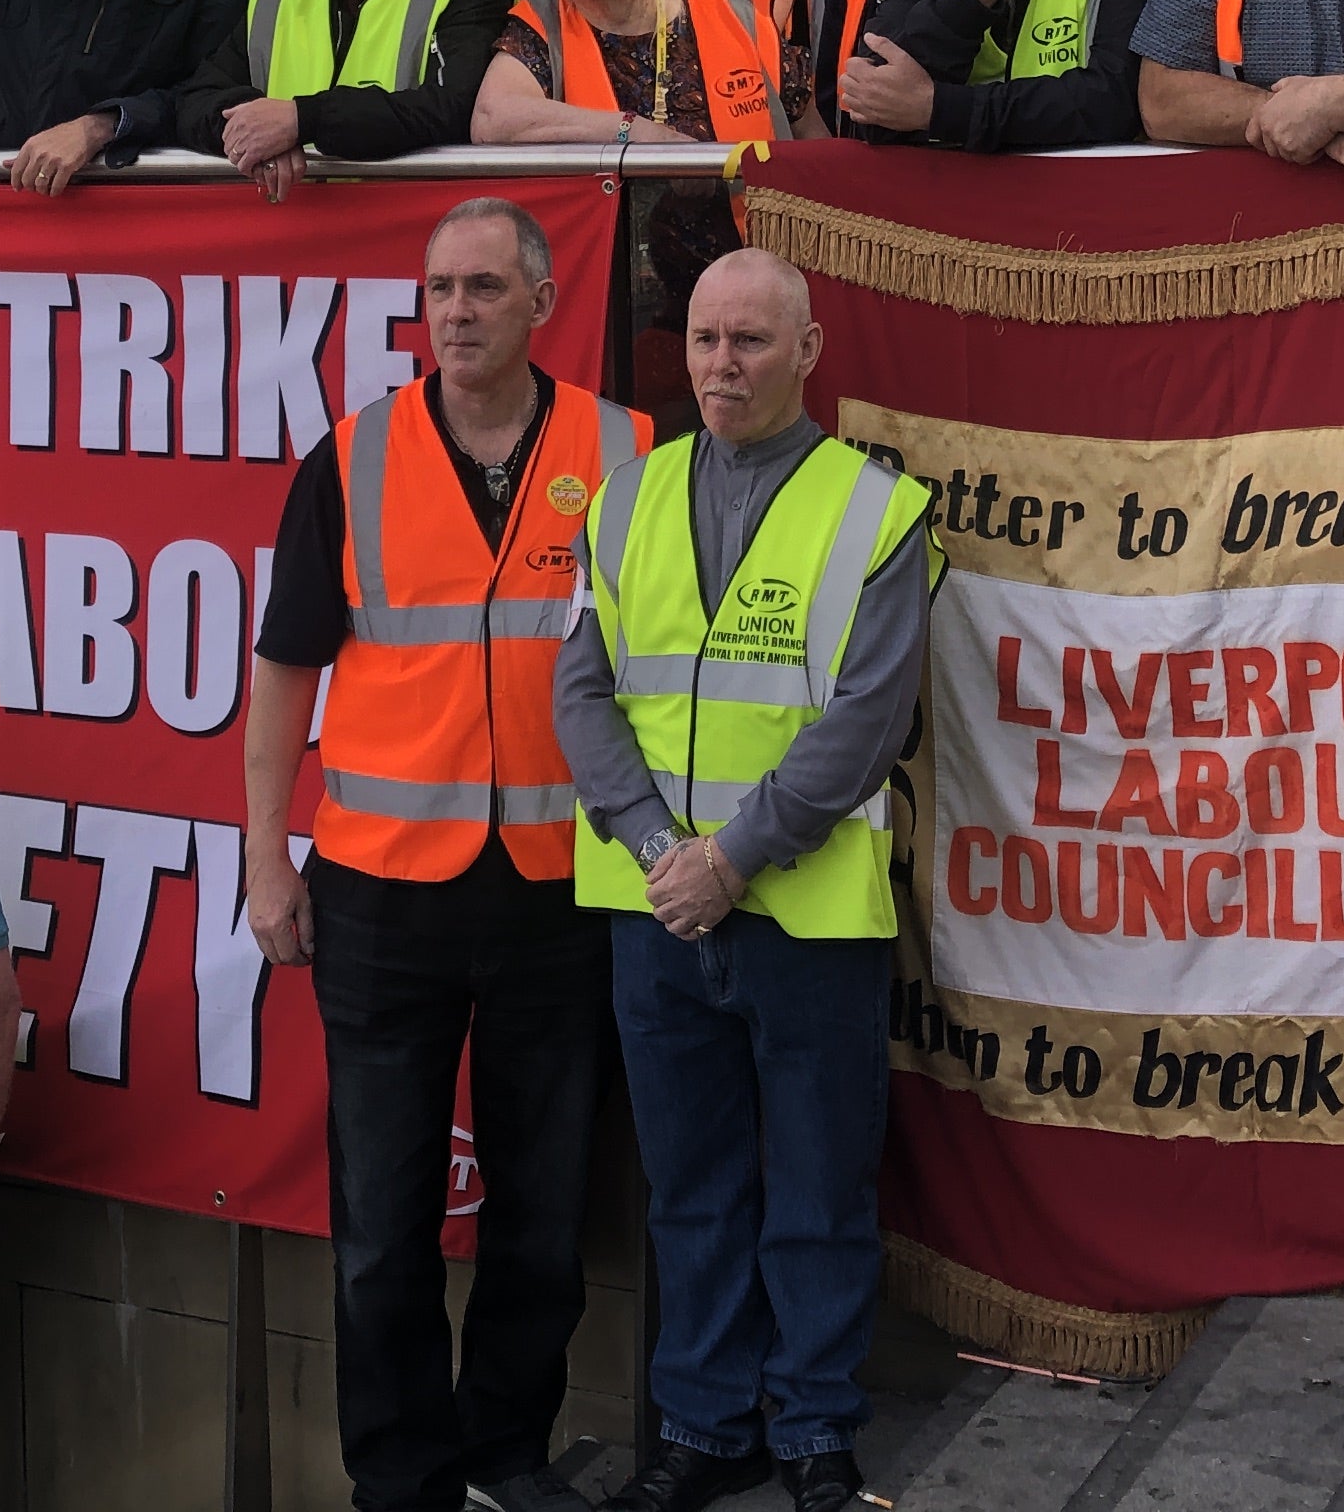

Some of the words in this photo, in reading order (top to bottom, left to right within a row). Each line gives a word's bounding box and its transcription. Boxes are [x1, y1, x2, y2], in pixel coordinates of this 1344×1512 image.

[727, 76, 754, 92] RMT
[728, 97, 768, 118] UNION
[1117, 491, 1188, 560] to
[537, 555, 575, 567] RMT
[750, 589, 789, 604] RMT
[738, 616, 795, 635] UNION
[711, 631, 761, 646] LIVERPOOL
[762, 635, 769, 647] 5
[704, 647, 731, 660] LOYAL
[734, 650, 745, 661] TO
[747, 651, 765, 663] ONE
[767, 652, 806, 666] ANOTHE
[1025, 1025, 1102, 1099] to
[1131, 1028, 1344, 1117] break
